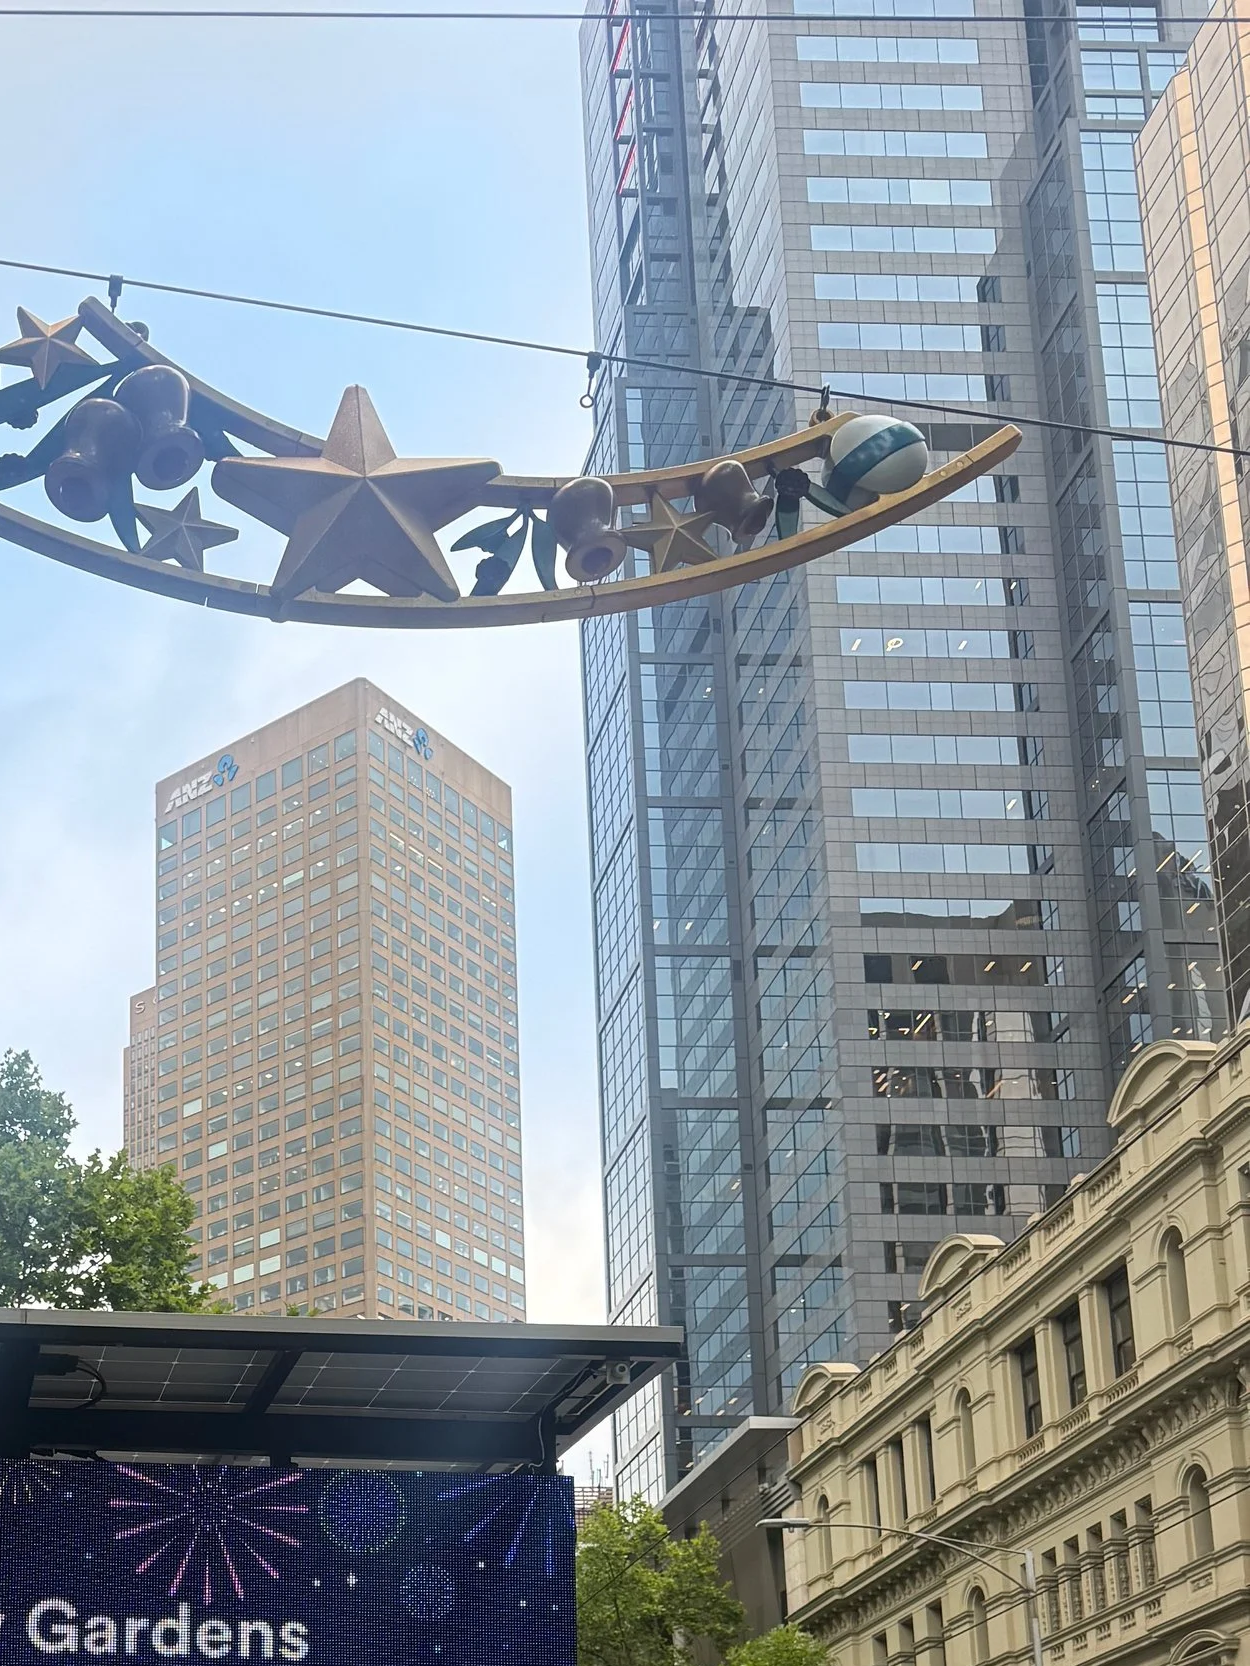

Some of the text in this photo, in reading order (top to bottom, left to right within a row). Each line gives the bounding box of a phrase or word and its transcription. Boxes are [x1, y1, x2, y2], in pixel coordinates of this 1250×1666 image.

[374, 707, 416, 748] ANZ
[164, 770, 214, 814] ANZ
[26, 1598, 310, 1661] Gardens
